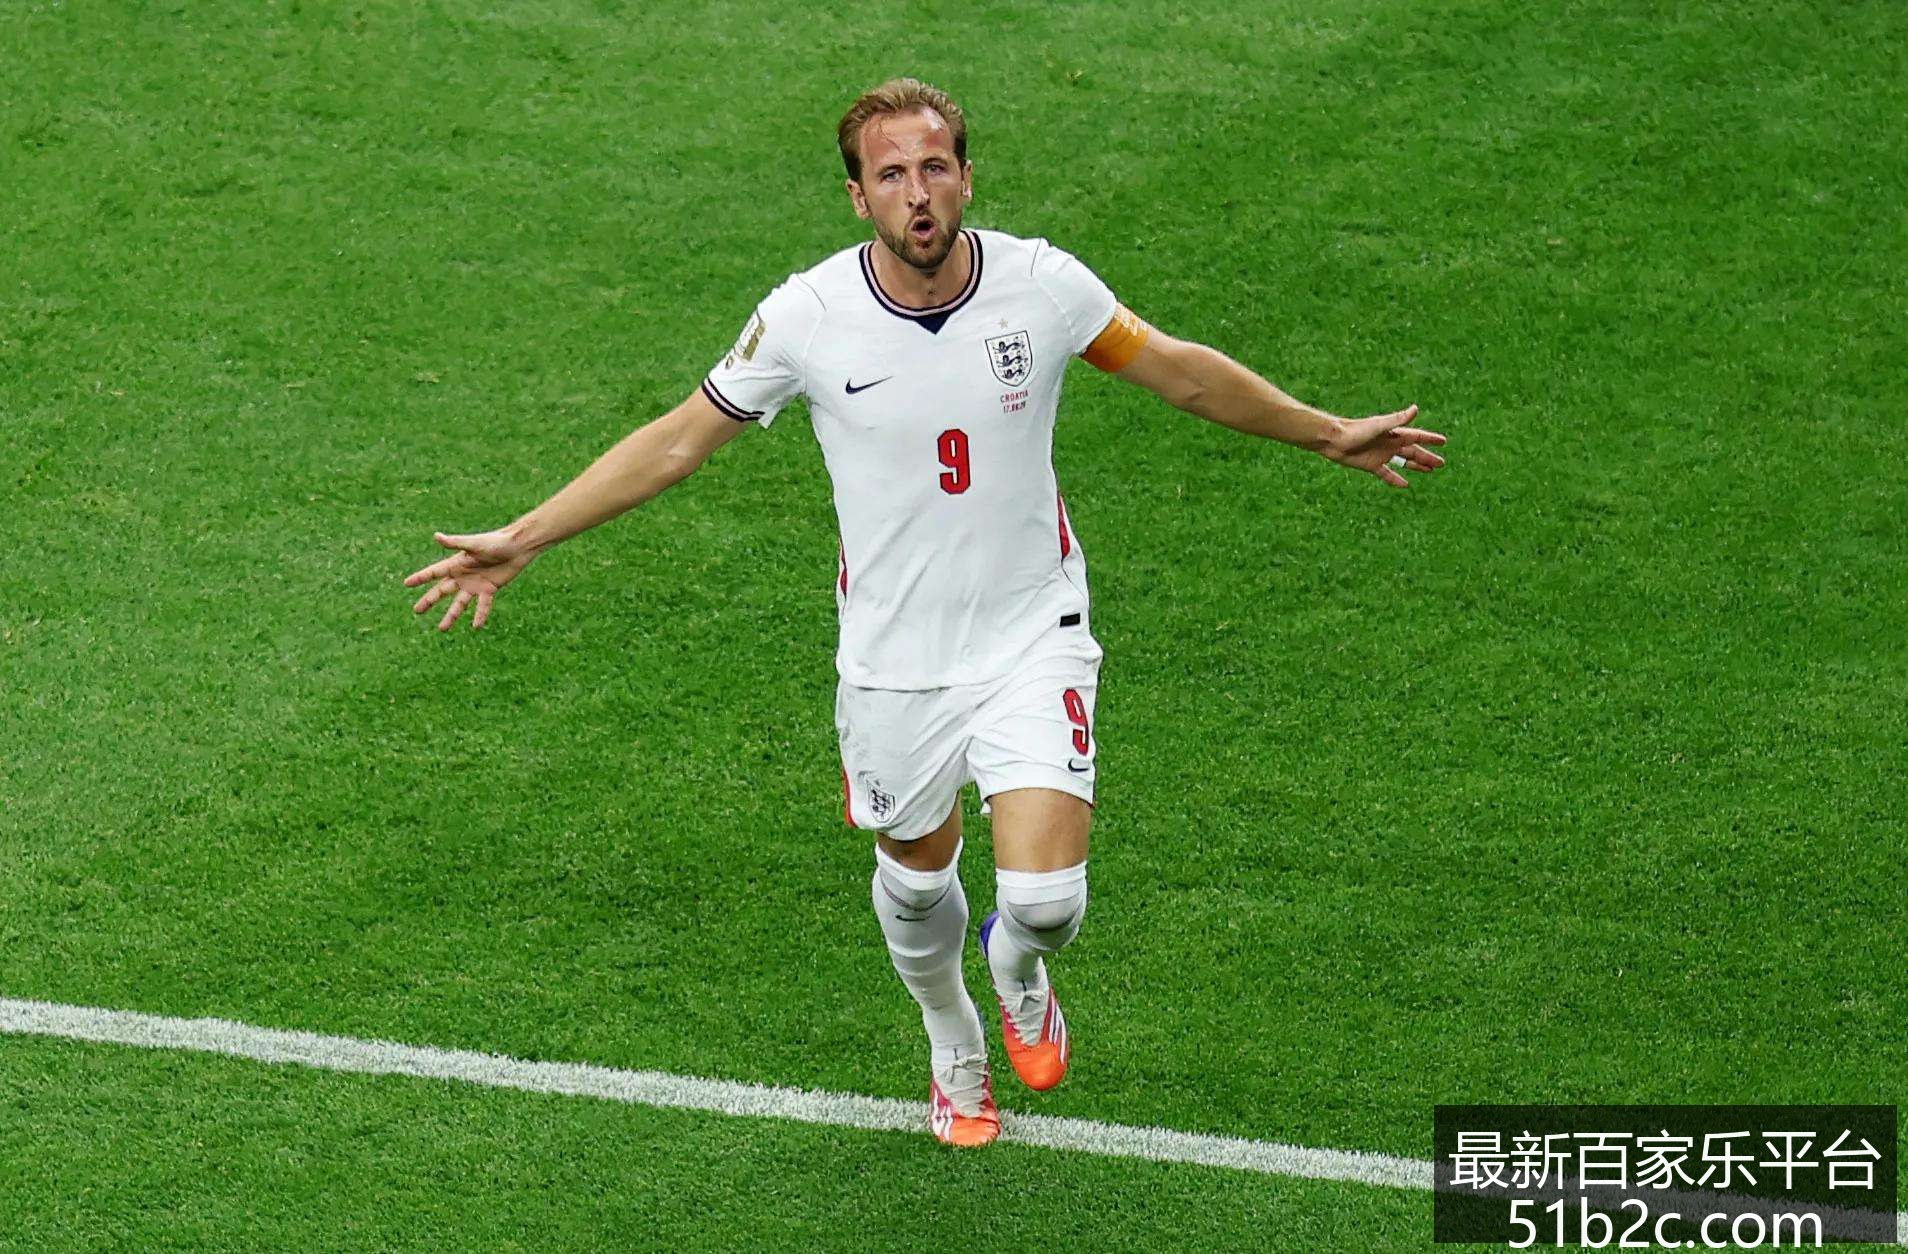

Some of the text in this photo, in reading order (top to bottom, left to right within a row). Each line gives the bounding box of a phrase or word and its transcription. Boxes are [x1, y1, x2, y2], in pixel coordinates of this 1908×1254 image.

[1000, 389, 1028, 403] CROATIA
[937, 429, 971, 495] 9
[1063, 688, 1089, 756] 9
